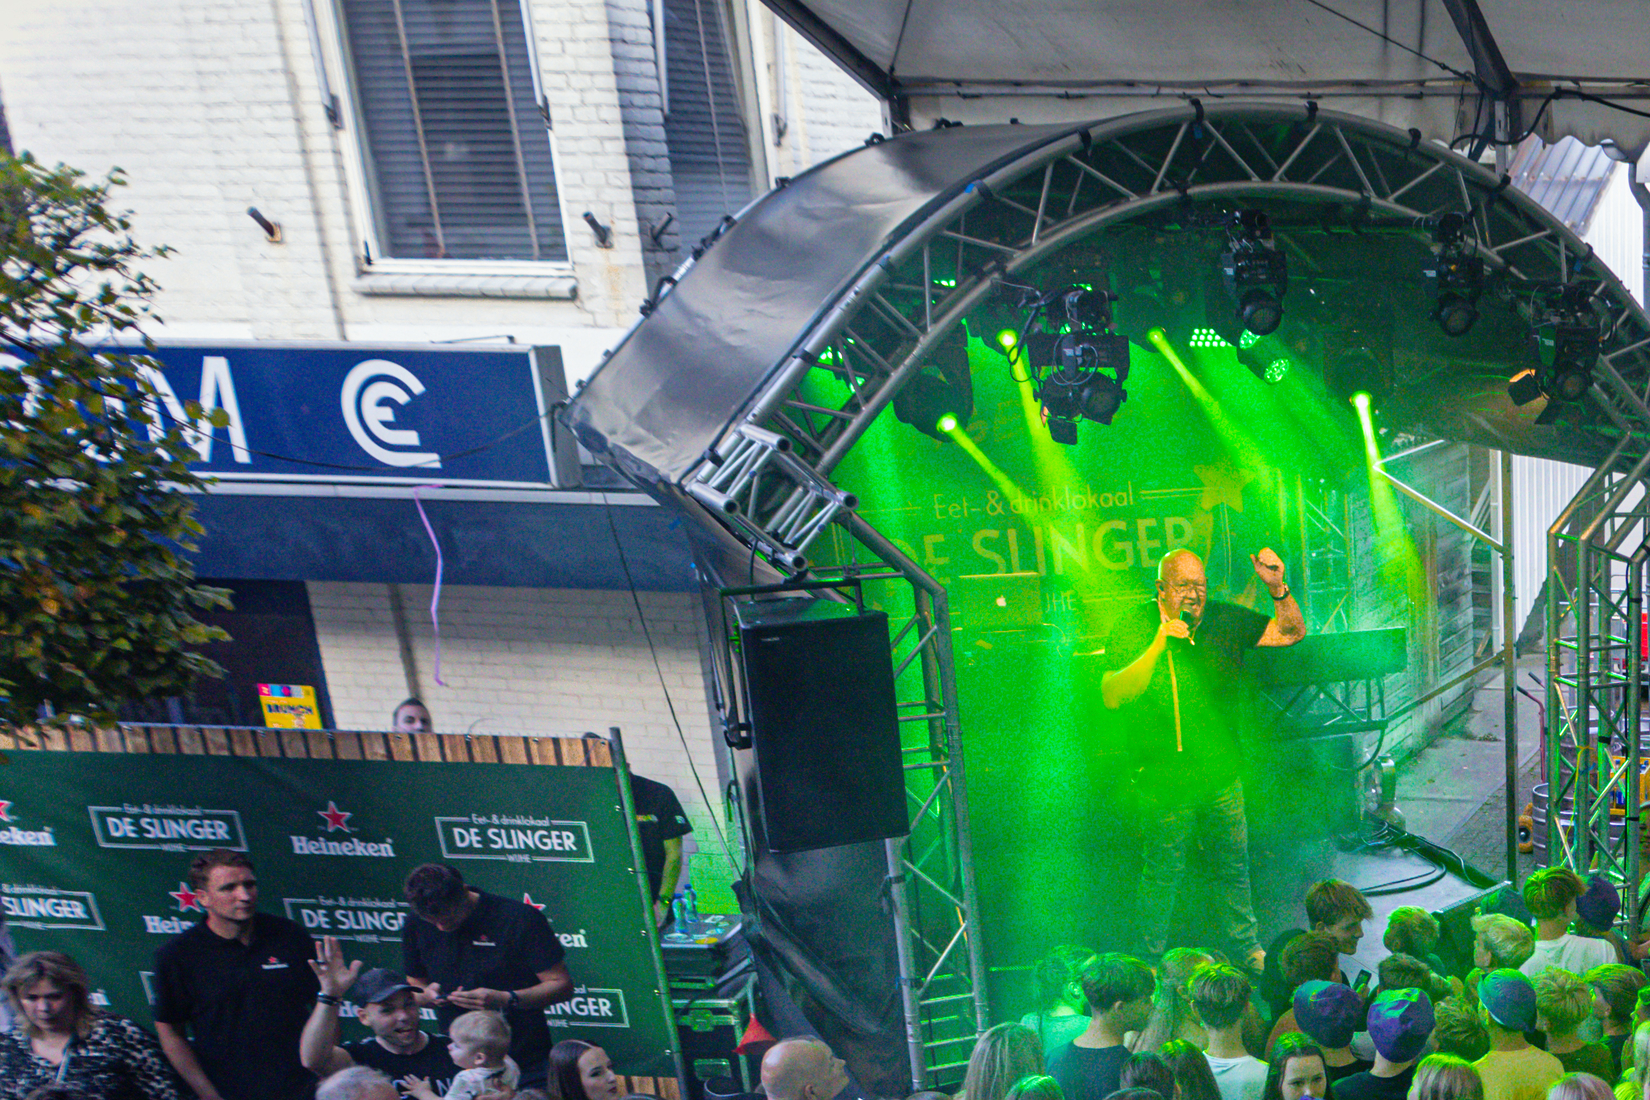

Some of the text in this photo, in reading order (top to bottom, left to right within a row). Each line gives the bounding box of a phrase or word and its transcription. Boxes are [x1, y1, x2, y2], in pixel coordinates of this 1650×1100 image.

[933, 481, 1134, 520] Eet- & drinklokaal
[0, 826, 57, 846] eken
[105, 816, 232, 840] DE SLINGER
[452, 827, 578, 851] DE SLINGER
[289, 835, 397, 858] Heineken
[1, 896, 91, 919] SLINGER
[300, 908, 332, 929] DE
